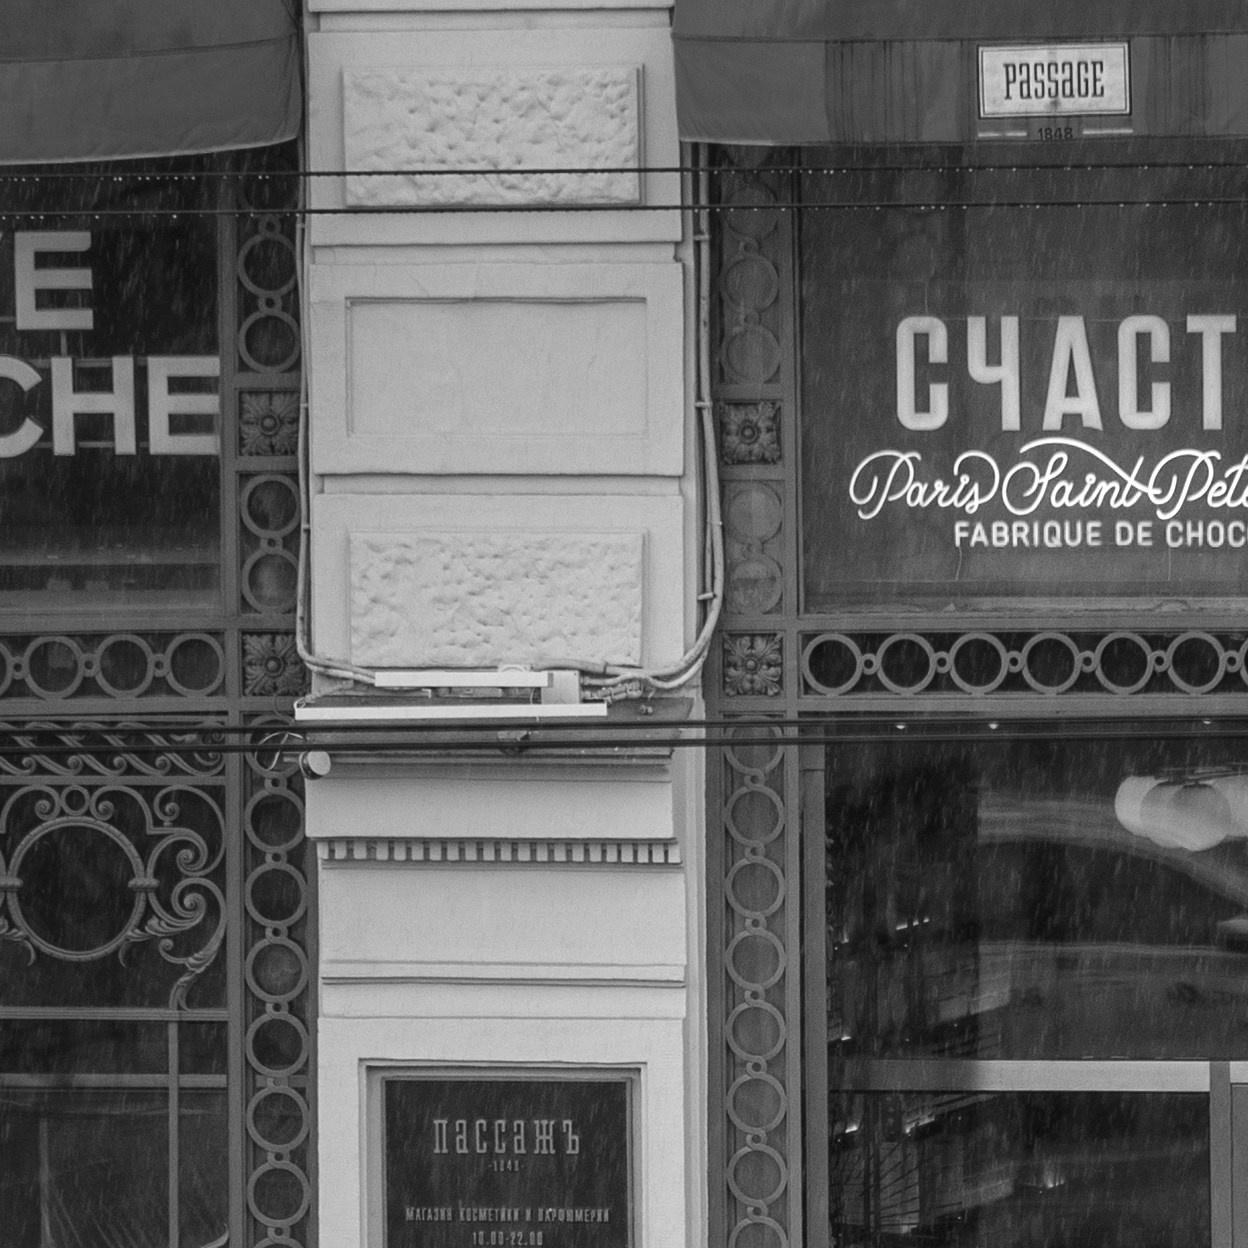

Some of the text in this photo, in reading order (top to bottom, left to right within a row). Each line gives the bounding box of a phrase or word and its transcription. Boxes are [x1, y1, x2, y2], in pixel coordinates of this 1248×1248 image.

[1003, 60, 1105, 100] PASSAGE
[1037, 127, 1073, 140] 1848
[849, 449, 1000, 519] Paris
[1001, 437, 1163, 516] Saint
[954, 520, 1102, 548] FABRIQUE
[1114, 520, 1154, 547] DE
[432, 1119, 580, 1154] ПАССАЖЪ
[405, 1207, 452, 1222] МАГАЗИН
[459, 1207, 520, 1222] КОСМЕТИКИ
